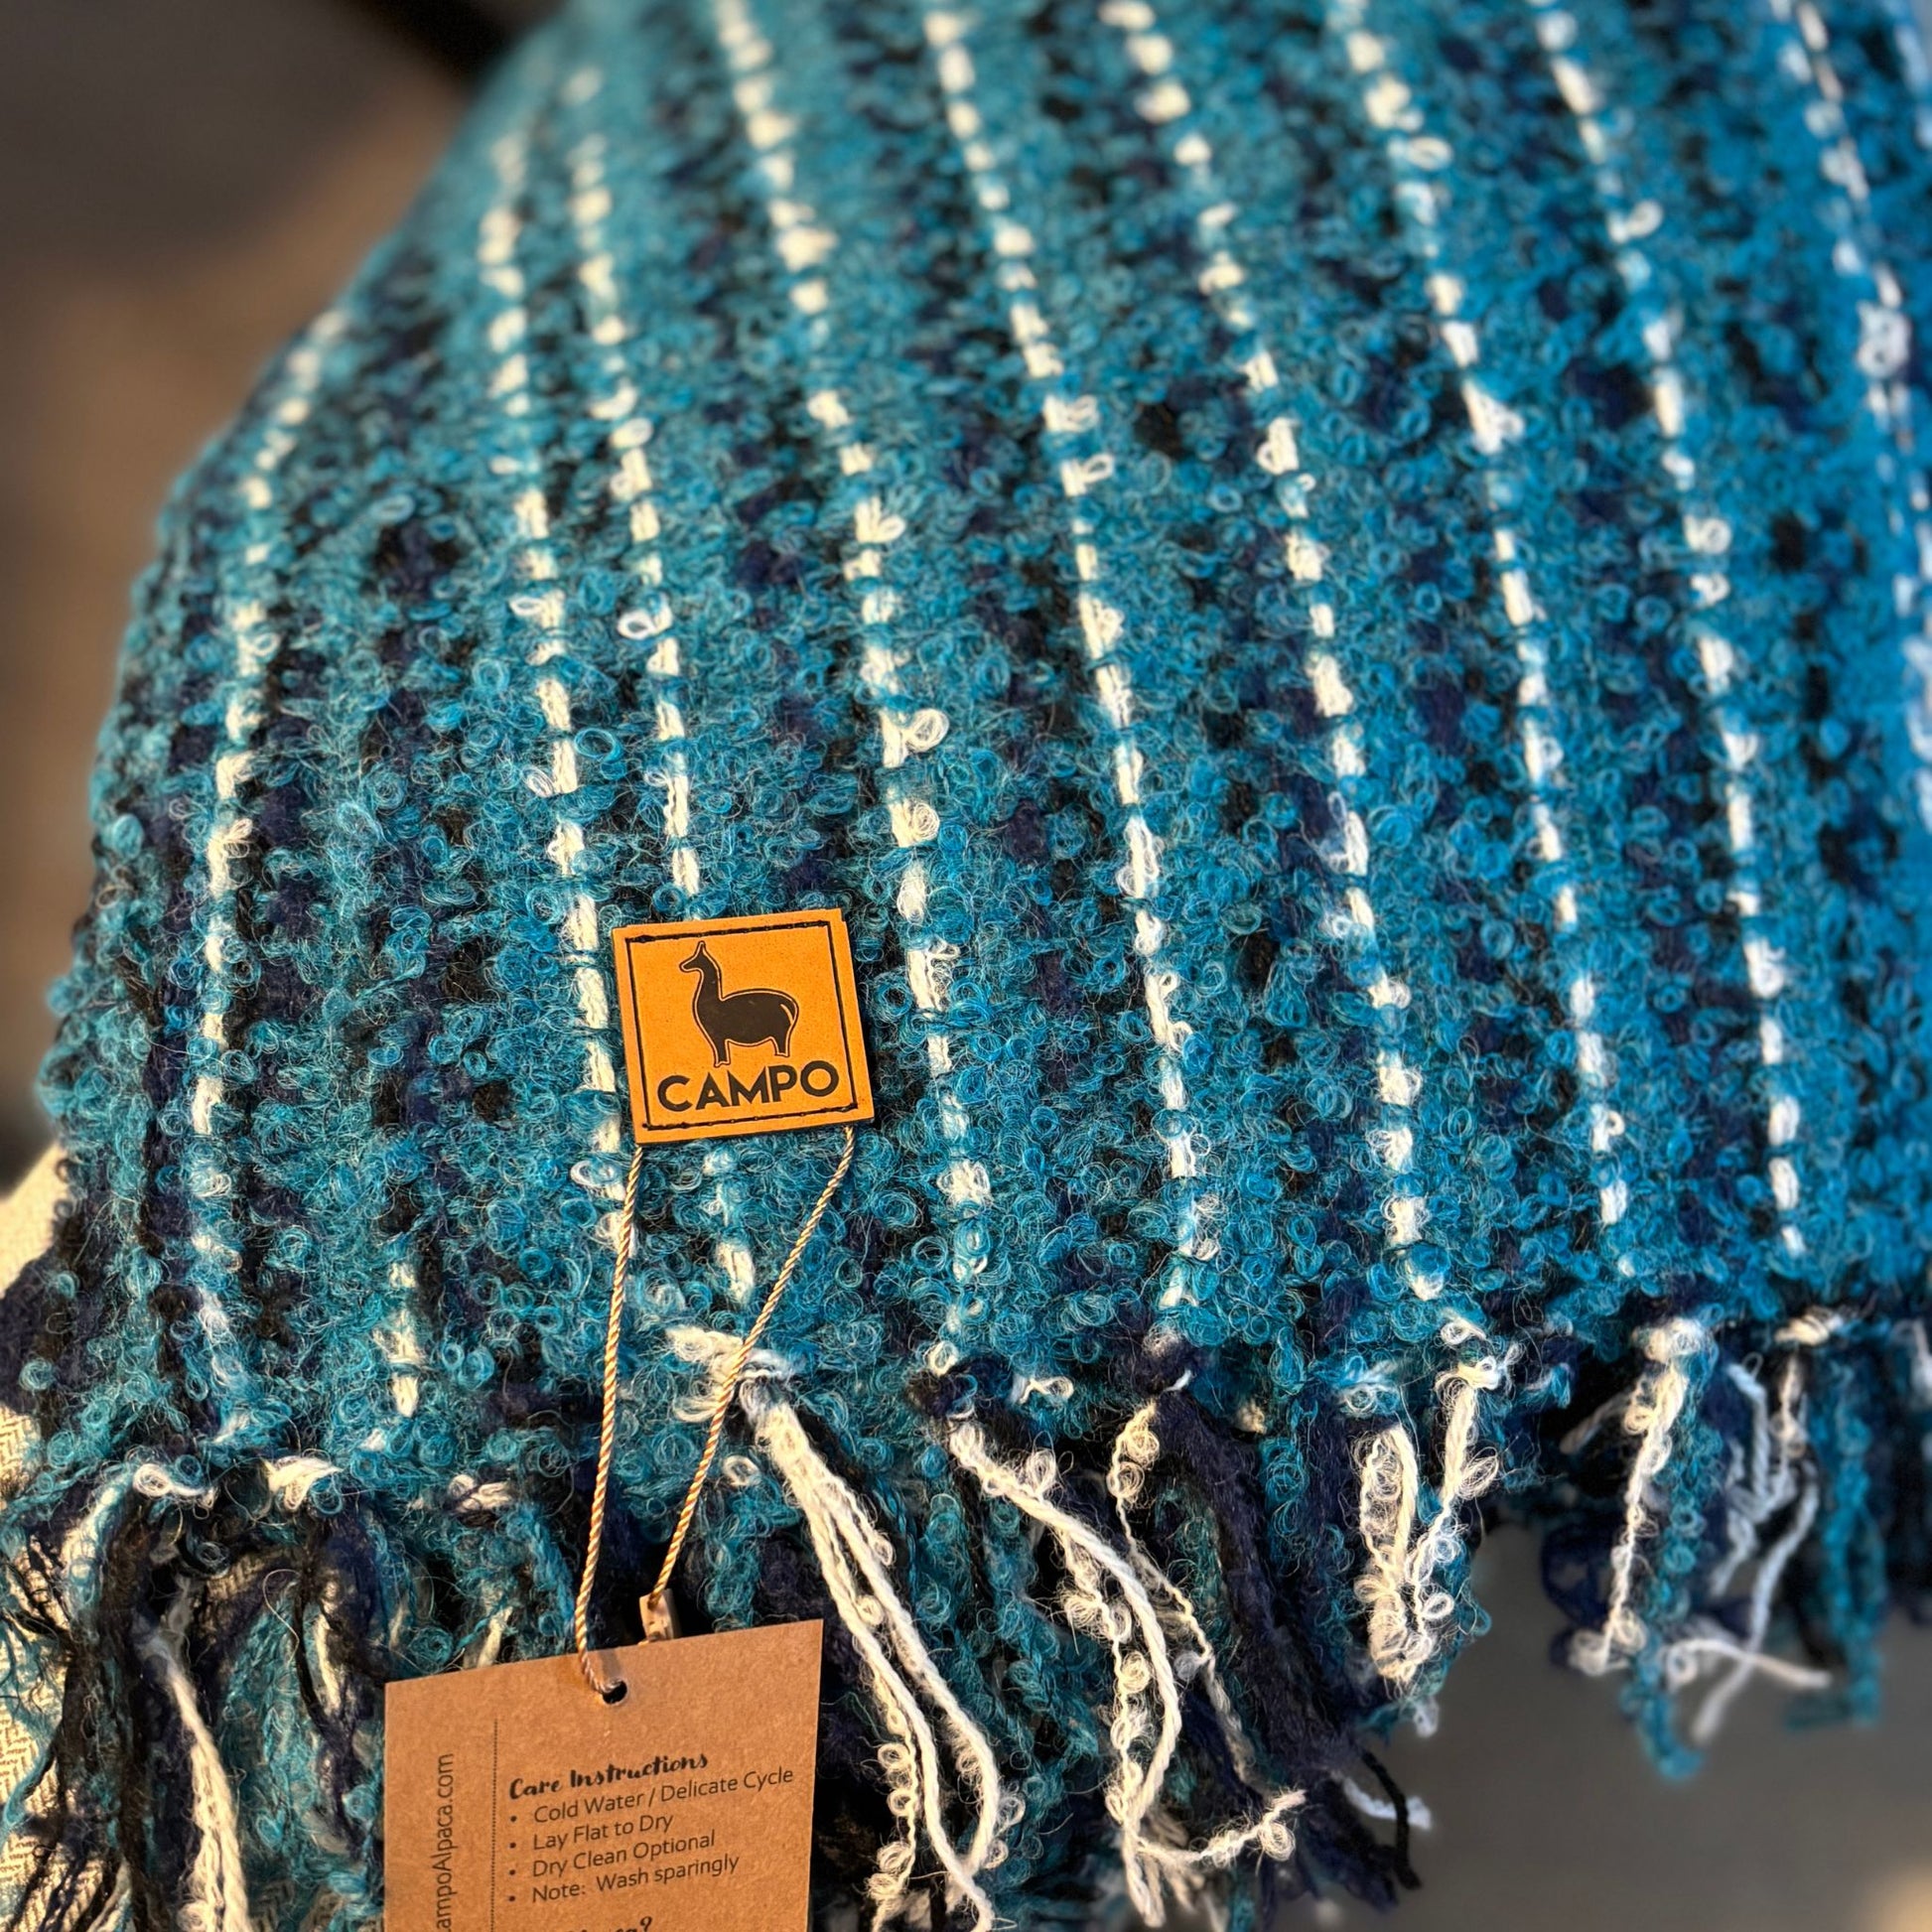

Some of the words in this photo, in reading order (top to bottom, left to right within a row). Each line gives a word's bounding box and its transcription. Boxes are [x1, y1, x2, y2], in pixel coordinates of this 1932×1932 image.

[657, 1060, 839, 1112] CAMPO
[509, 1778, 562, 1800] Care
[570, 1753, 708, 1788] Instructions
[534, 1800, 579, 1823] Cold
[584, 1792, 644, 1815] Water
[648, 1787, 656, 1807] /
[661, 1778, 738, 1802] Delicate
[744, 1766, 793, 1791] Cycle
[431, 1753, 459, 1932] ampoAlpaca.com
[532, 1860, 568, 1877] Dry
[573, 1850, 627, 1870] Clean
[632, 1829, 715, 1862] Optional
[533, 1833, 568, 1851] Lay
[574, 1824, 609, 1843] Flat
[614, 1821, 633, 1837] to
[639, 1815, 674, 1833] Dry
[532, 1883, 586, 1903] Note:
[597, 1867, 648, 1891] Wash
[654, 1853, 740, 1884] sparingly
